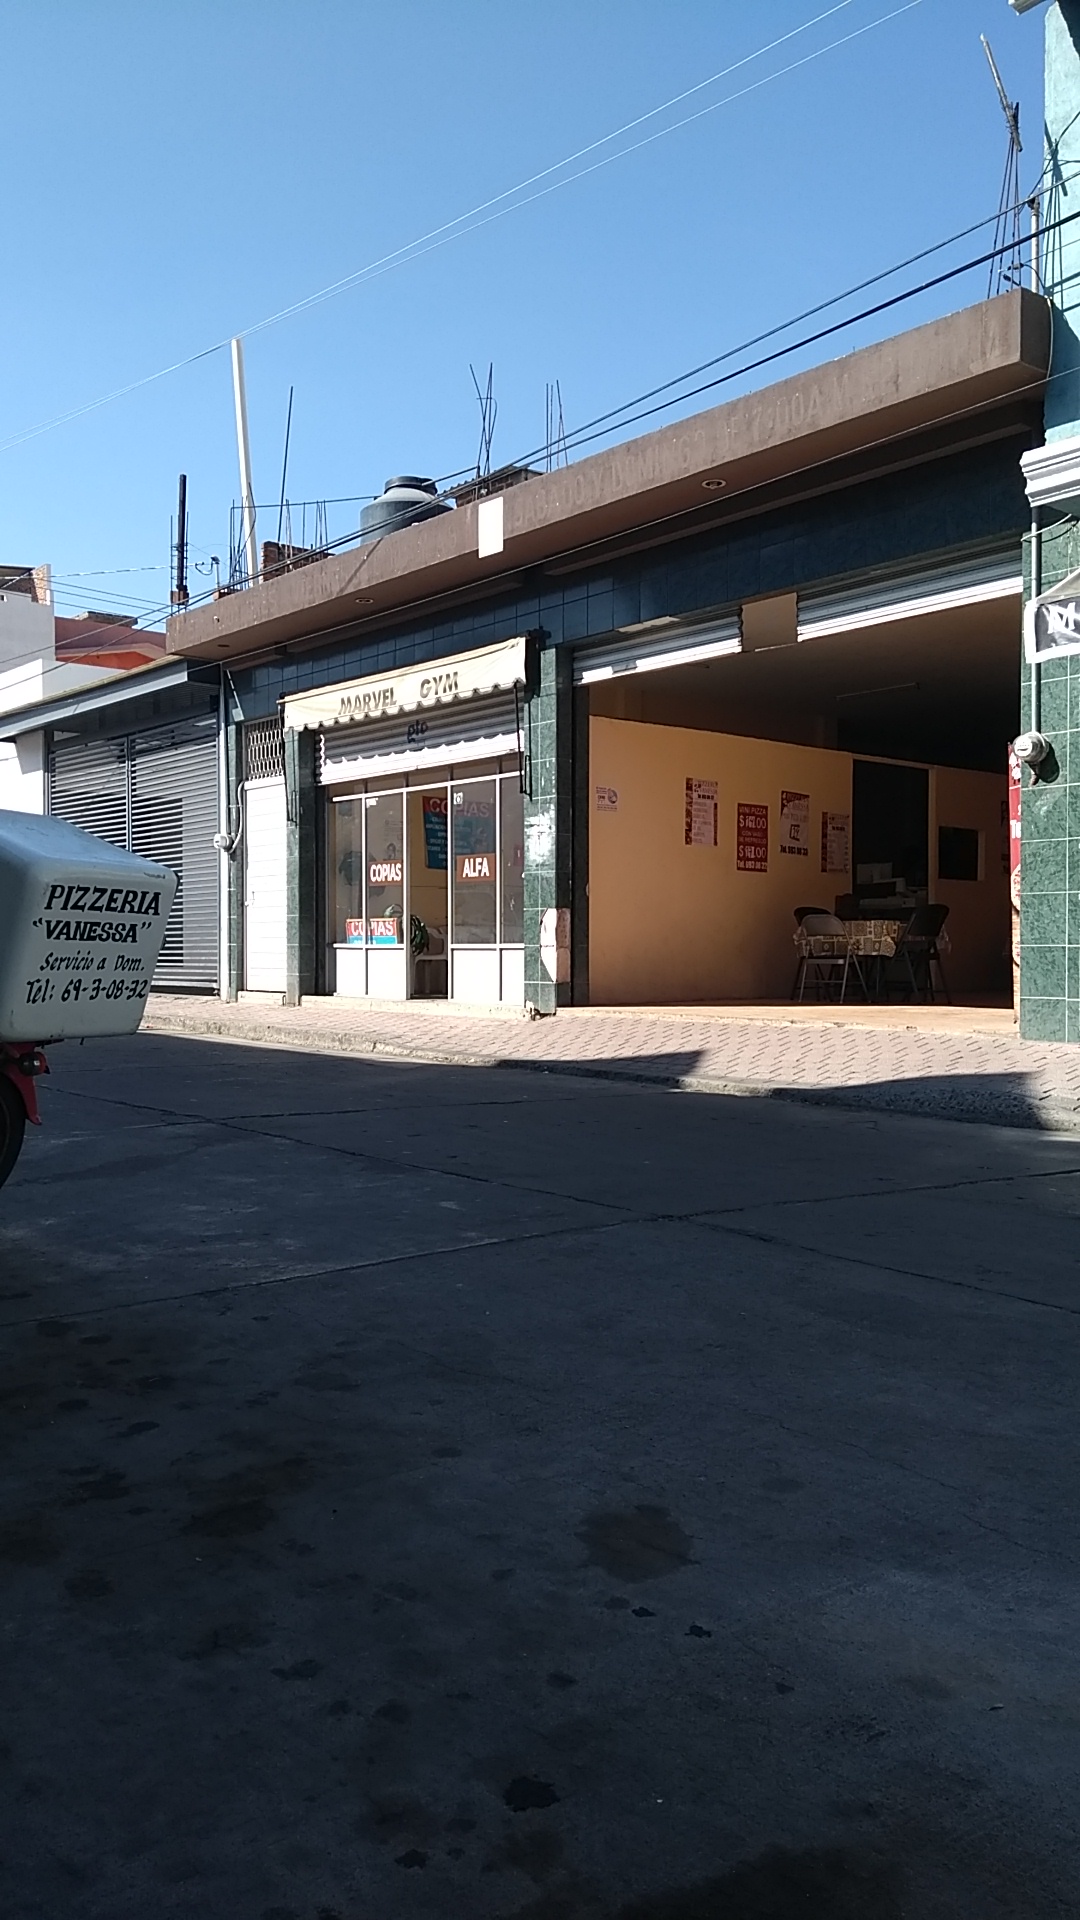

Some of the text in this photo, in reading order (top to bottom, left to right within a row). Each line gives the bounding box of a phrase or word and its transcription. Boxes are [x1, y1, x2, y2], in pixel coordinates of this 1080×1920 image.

[337, 671, 459, 715] MARVEL GYM
[428, 797, 490, 818] COPIAS
[369, 863, 402, 883] COPIAS
[461, 857, 490, 878] ALFA
[44, 884, 162, 916] PIZZERIA
[32, 917, 152, 943] "VANESSA"
[350, 921, 394, 936] COPIAS
[40, 950, 145, 971] Servicio a Dom.
[26, 978, 148, 1004] Tel: 69-3-08-32
